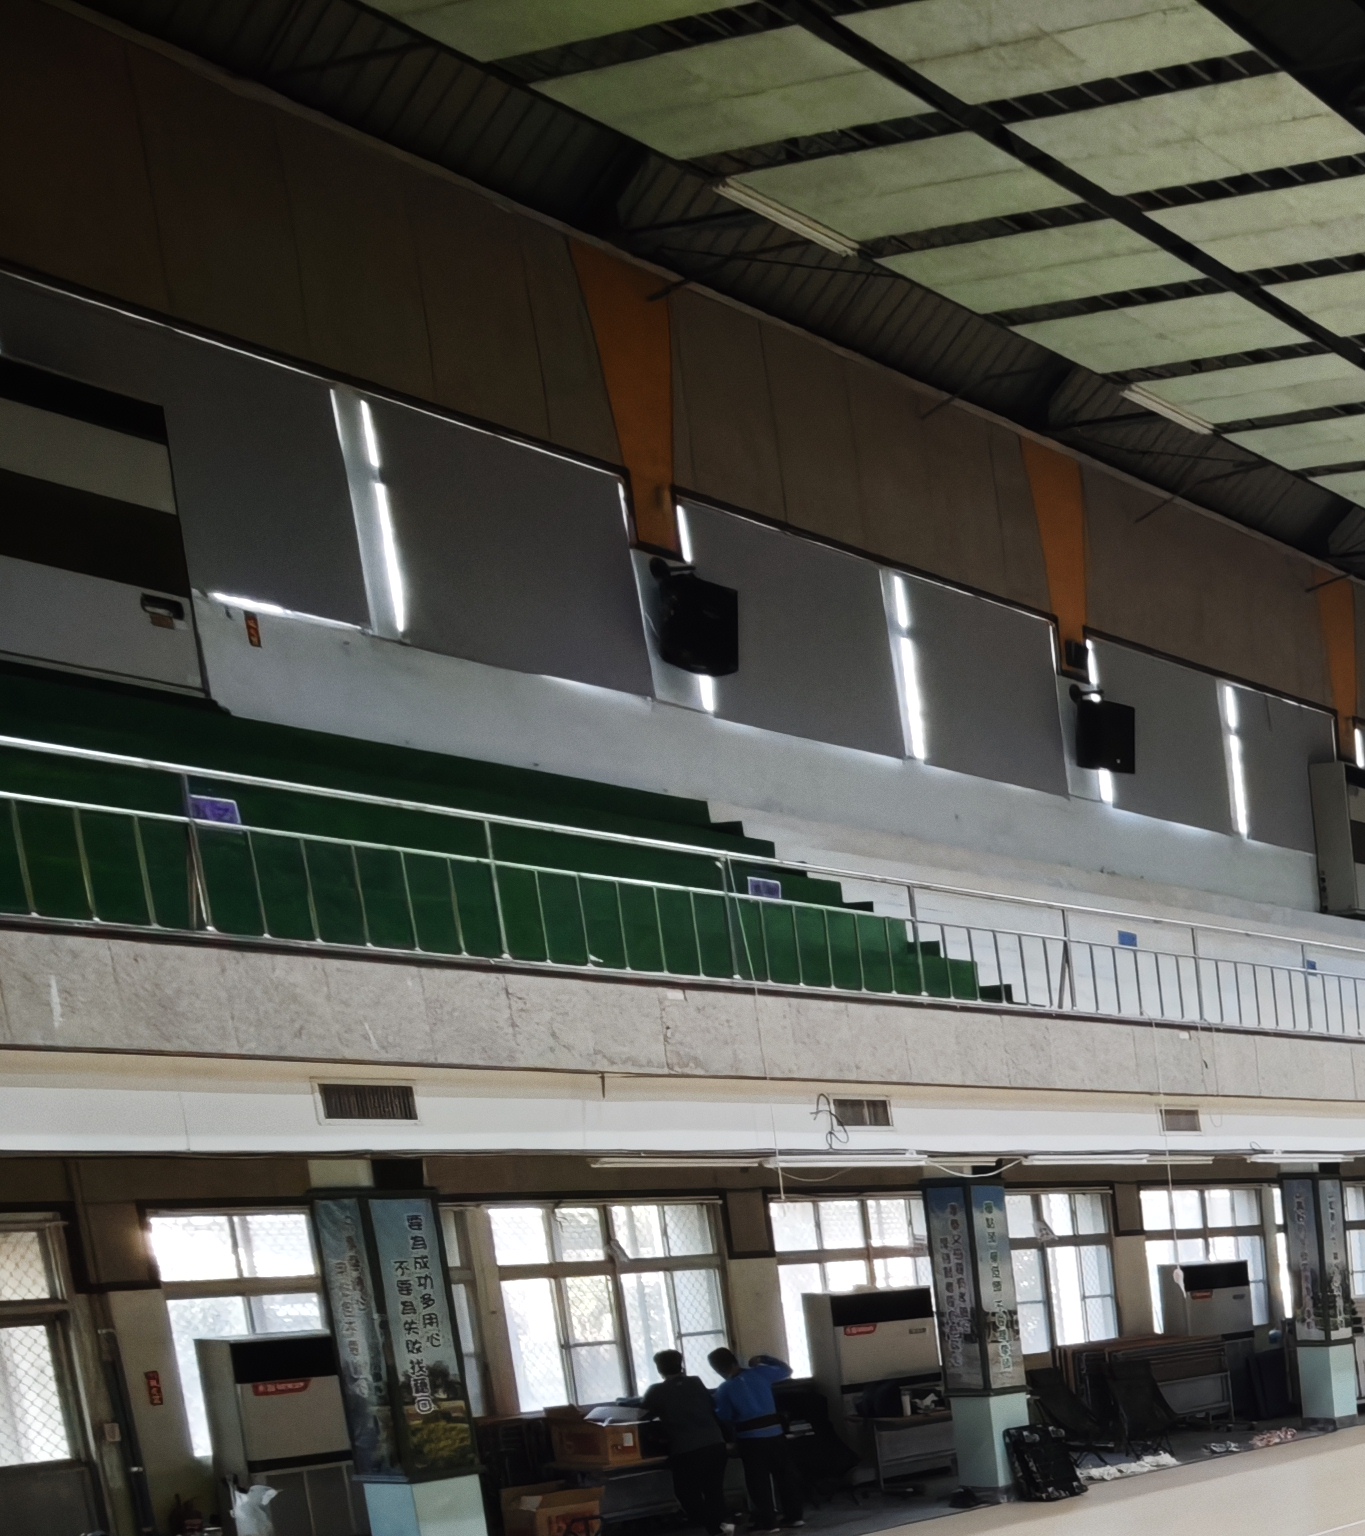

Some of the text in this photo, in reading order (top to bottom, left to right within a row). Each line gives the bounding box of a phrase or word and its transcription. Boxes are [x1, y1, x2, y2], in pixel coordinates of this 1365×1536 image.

[406, 1214, 441, 1348] 要為成功多用心
